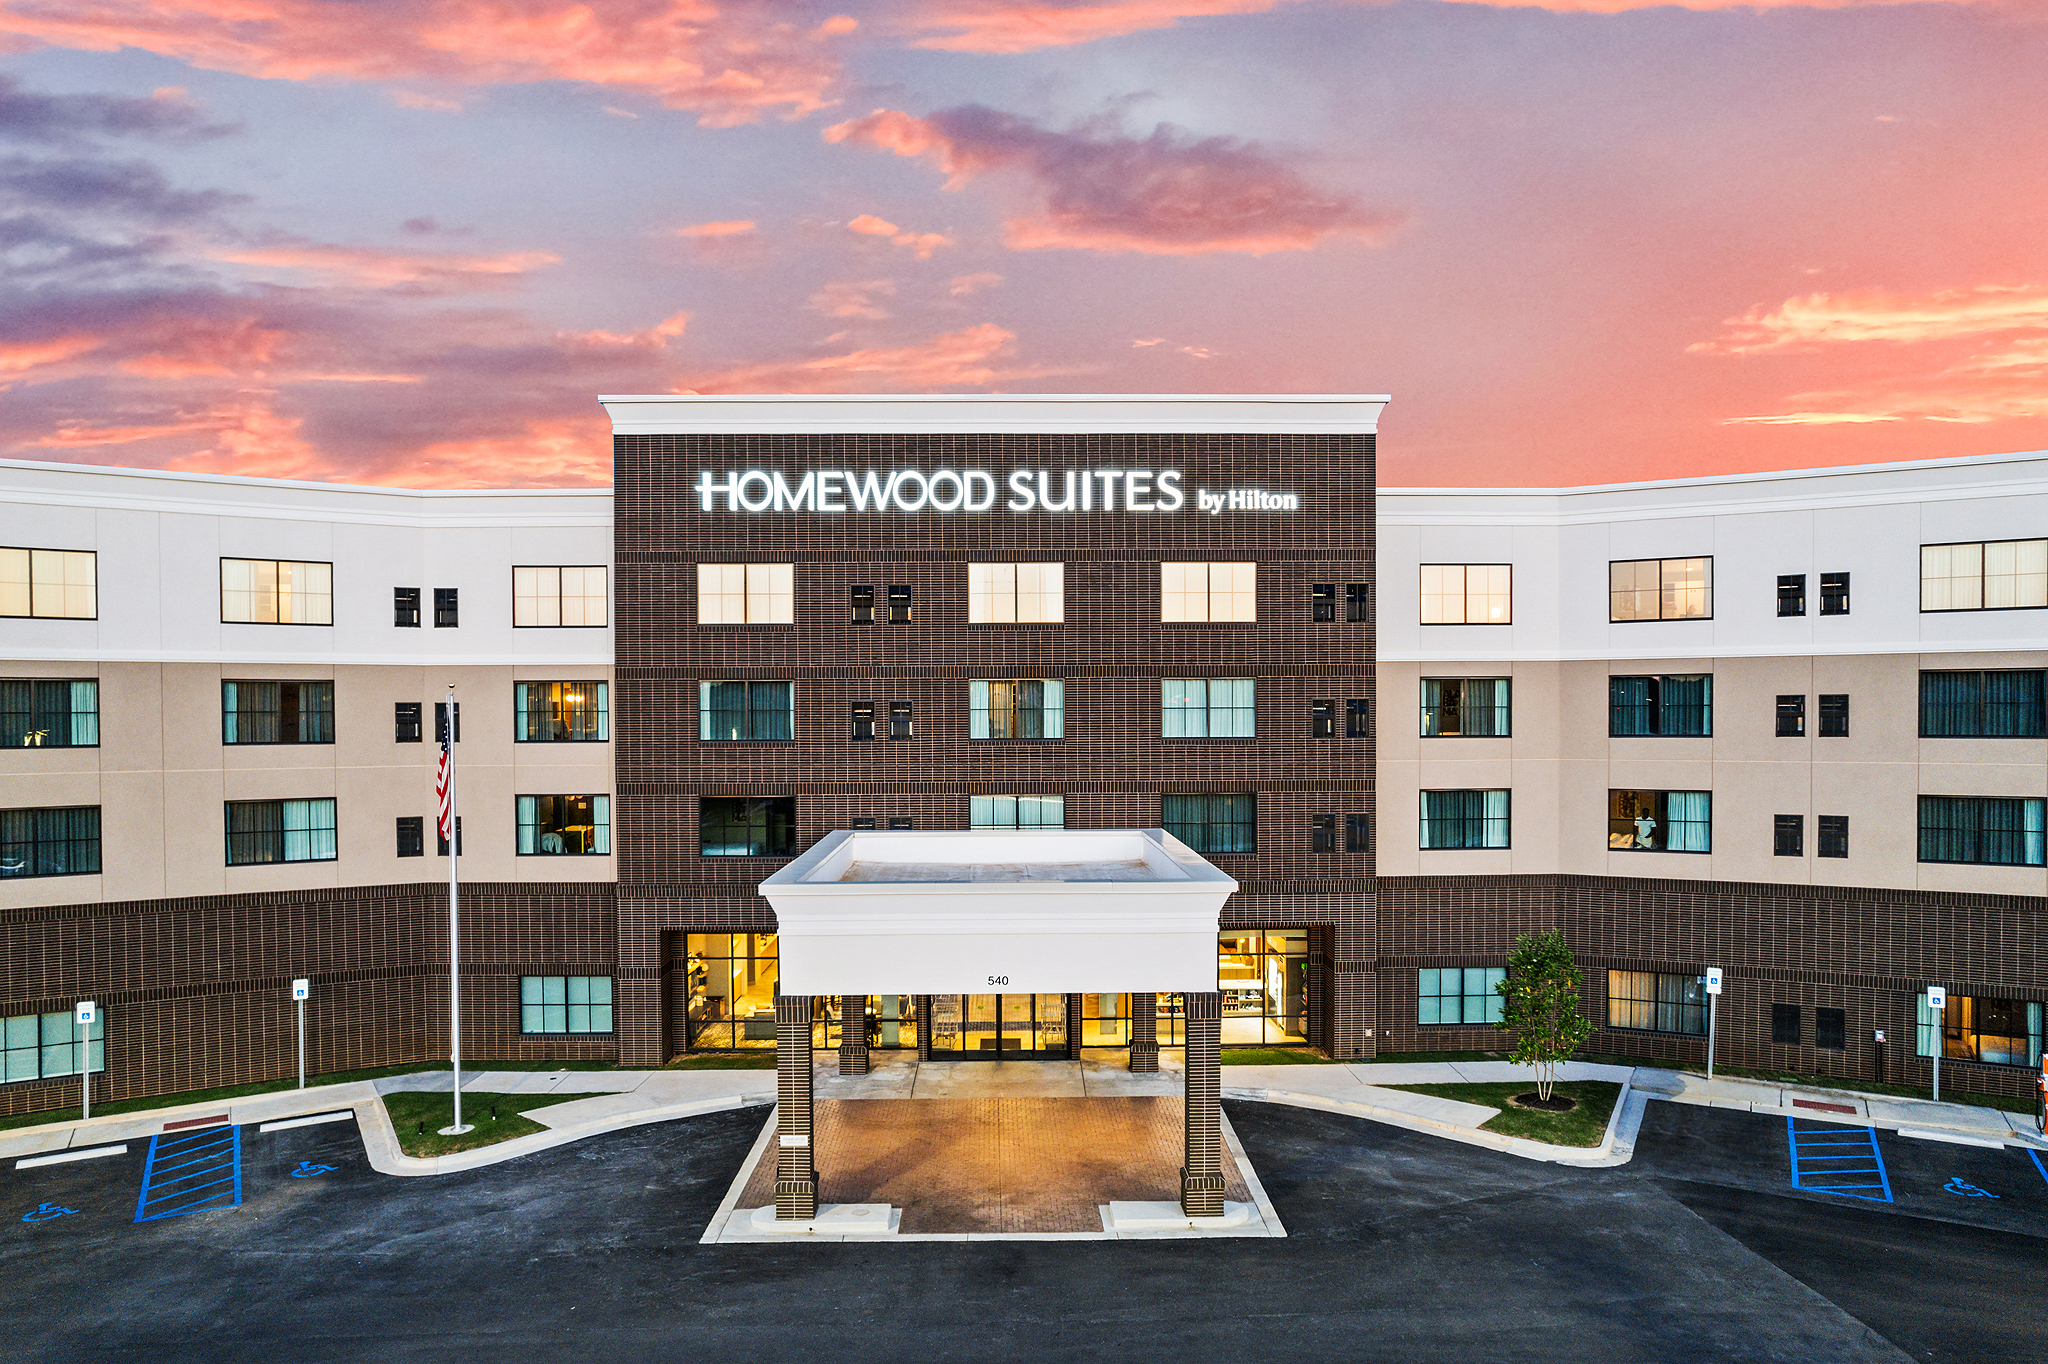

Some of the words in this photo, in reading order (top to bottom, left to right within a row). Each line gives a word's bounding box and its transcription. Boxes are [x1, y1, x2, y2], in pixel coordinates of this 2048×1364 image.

[695, 471, 995, 512] HOMEWOOD
[1008, 471, 1184, 511] SUITES
[1199, 489, 1226, 515] by
[1228, 490, 1298, 509] Hilton
[988, 976, 1009, 986] 540
